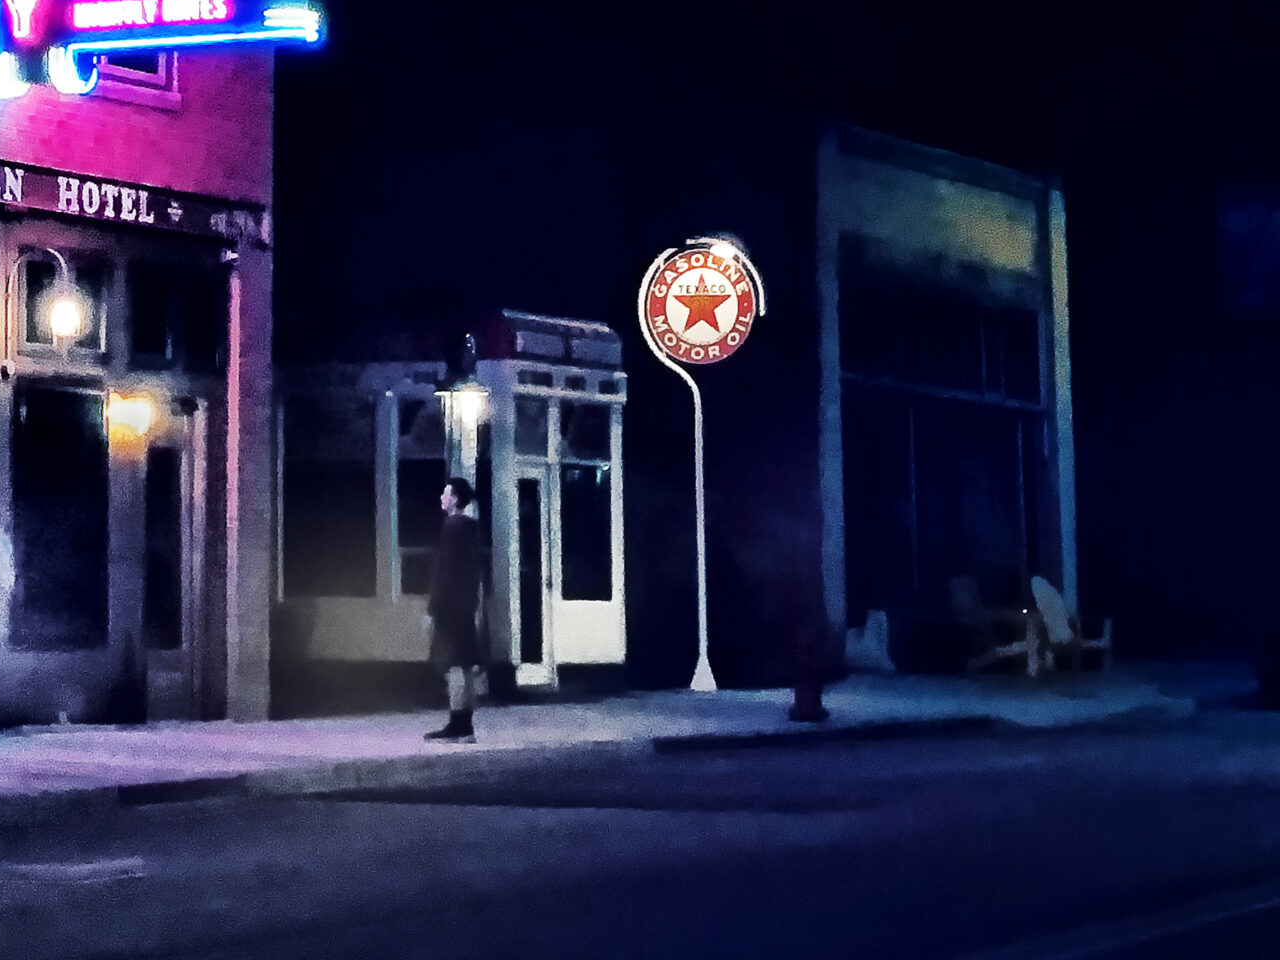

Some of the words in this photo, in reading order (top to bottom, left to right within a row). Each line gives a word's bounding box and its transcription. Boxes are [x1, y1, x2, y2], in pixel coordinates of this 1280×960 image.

[56, 176, 156, 226] HOTEL
[653, 253, 750, 298] GASOLINE
[678, 284, 727, 295] TEXACO
[653, 314, 721, 361] MOTOR
[726, 312, 752, 347] OIL
